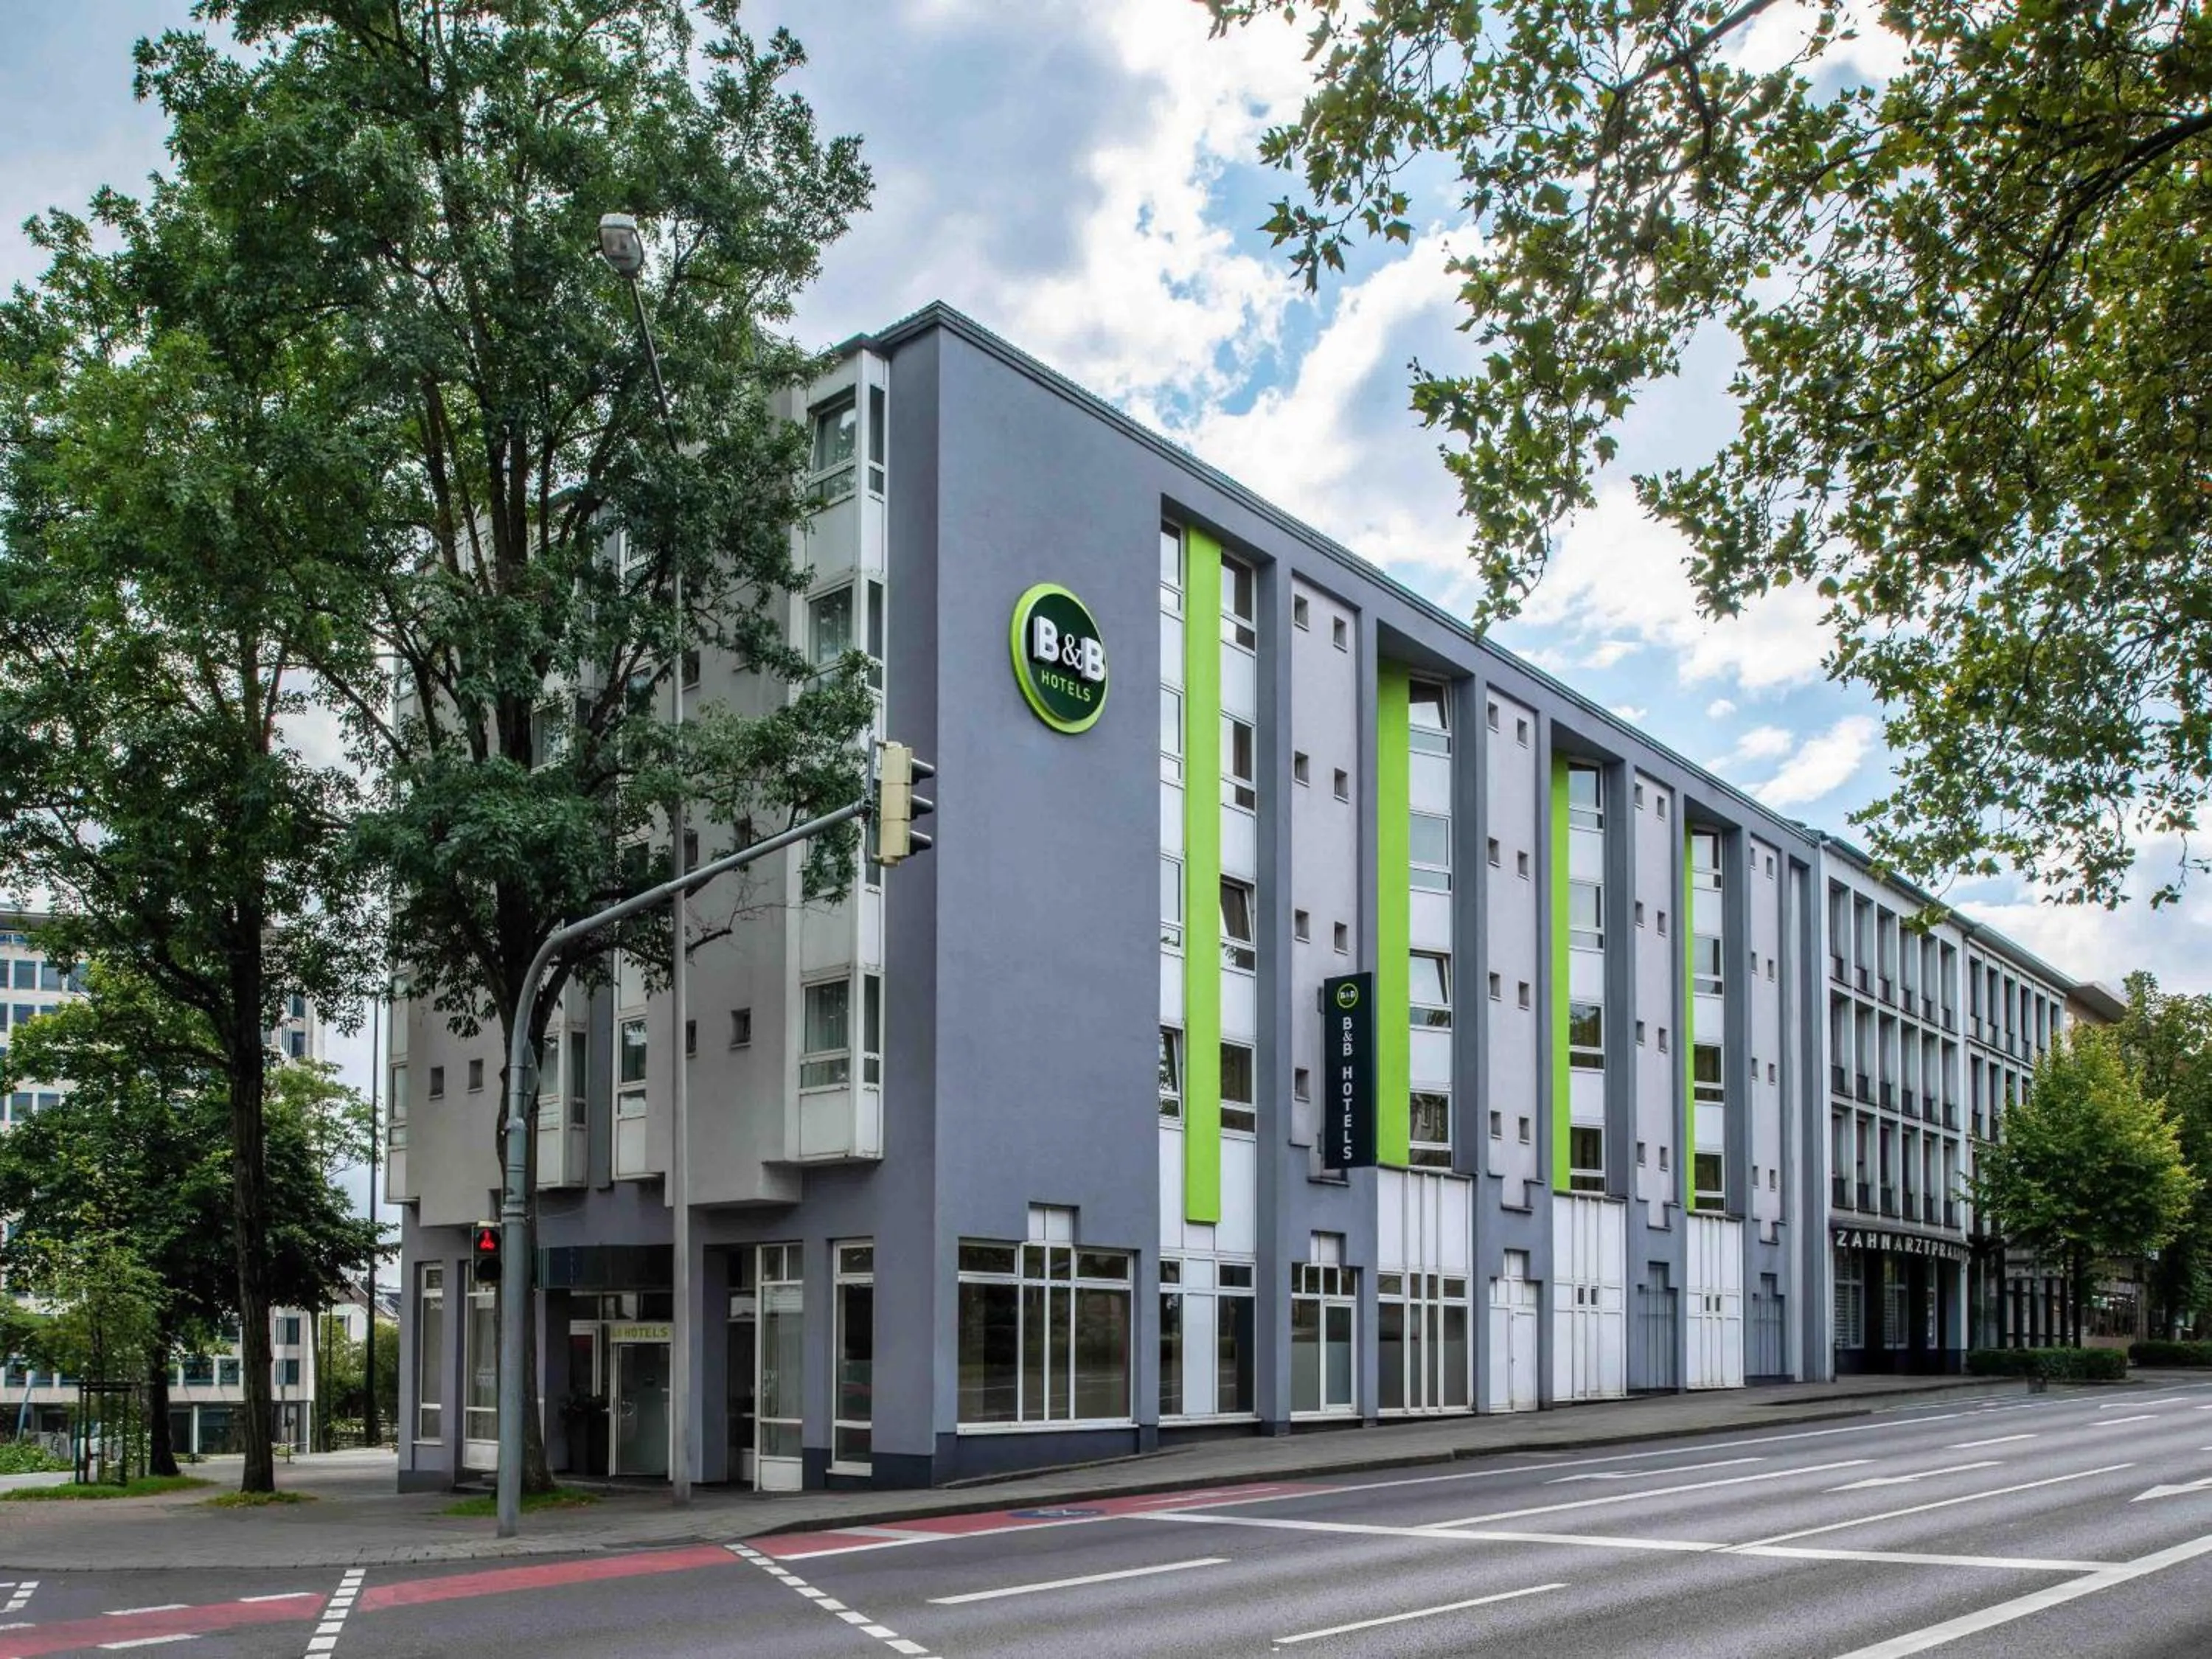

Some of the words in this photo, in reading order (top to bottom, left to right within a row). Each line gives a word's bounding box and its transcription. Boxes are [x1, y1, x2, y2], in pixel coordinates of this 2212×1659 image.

[1033, 616, 1105, 682] B&B
[1041, 669, 1091, 702] HOTELS
[1343, 1016, 1353, 1057] B&B
[1343, 1066, 1353, 1160] HOTELS
[1836, 1230, 1971, 1264] ZAHNARZTPRA
[624, 1326, 669, 1338] HOTELS
